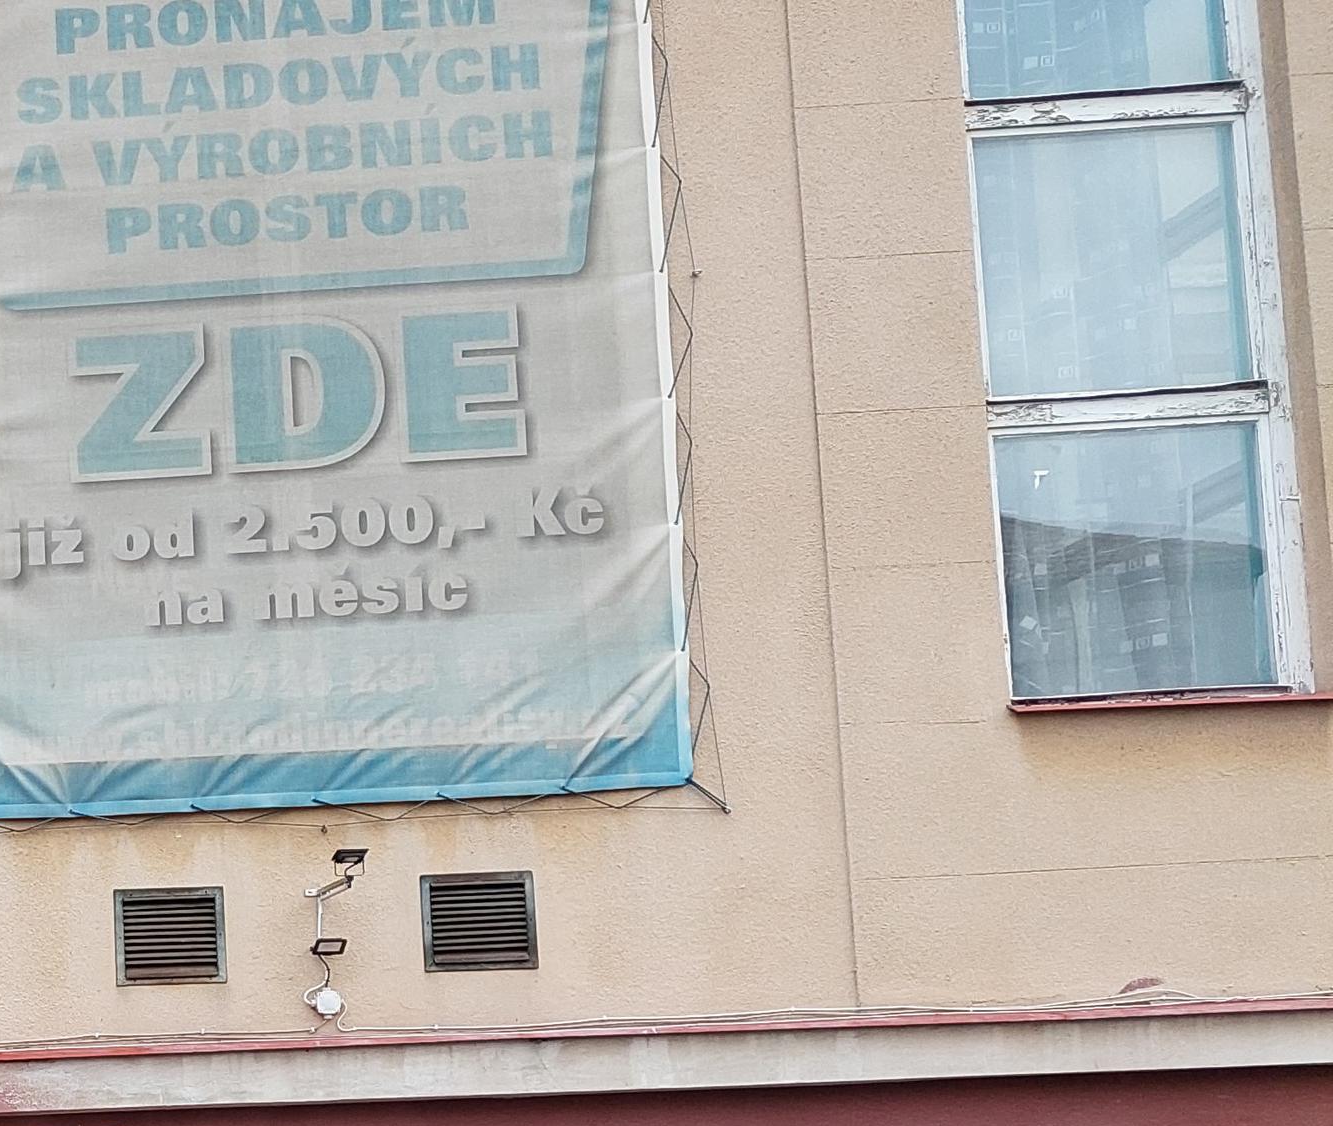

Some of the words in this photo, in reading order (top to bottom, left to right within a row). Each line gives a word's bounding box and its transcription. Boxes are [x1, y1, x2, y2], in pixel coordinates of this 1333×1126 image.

[17, 37, 541, 125] SKLADOVÝCH
[12, 144, 66, 195] A
[94, 110, 554, 188] VÝROBNÍCH
[104, 185, 470, 254] PROSTOR
[70, 306, 528, 484] ZDE
[5, 511, 85, 581] již
[113, 511, 194, 561] od
[226, 496, 486, 558] 2.500,-
[522, 486, 605, 538] Kč
[145, 585, 225, 628] na
[261, 565, 469, 622] měsíc
